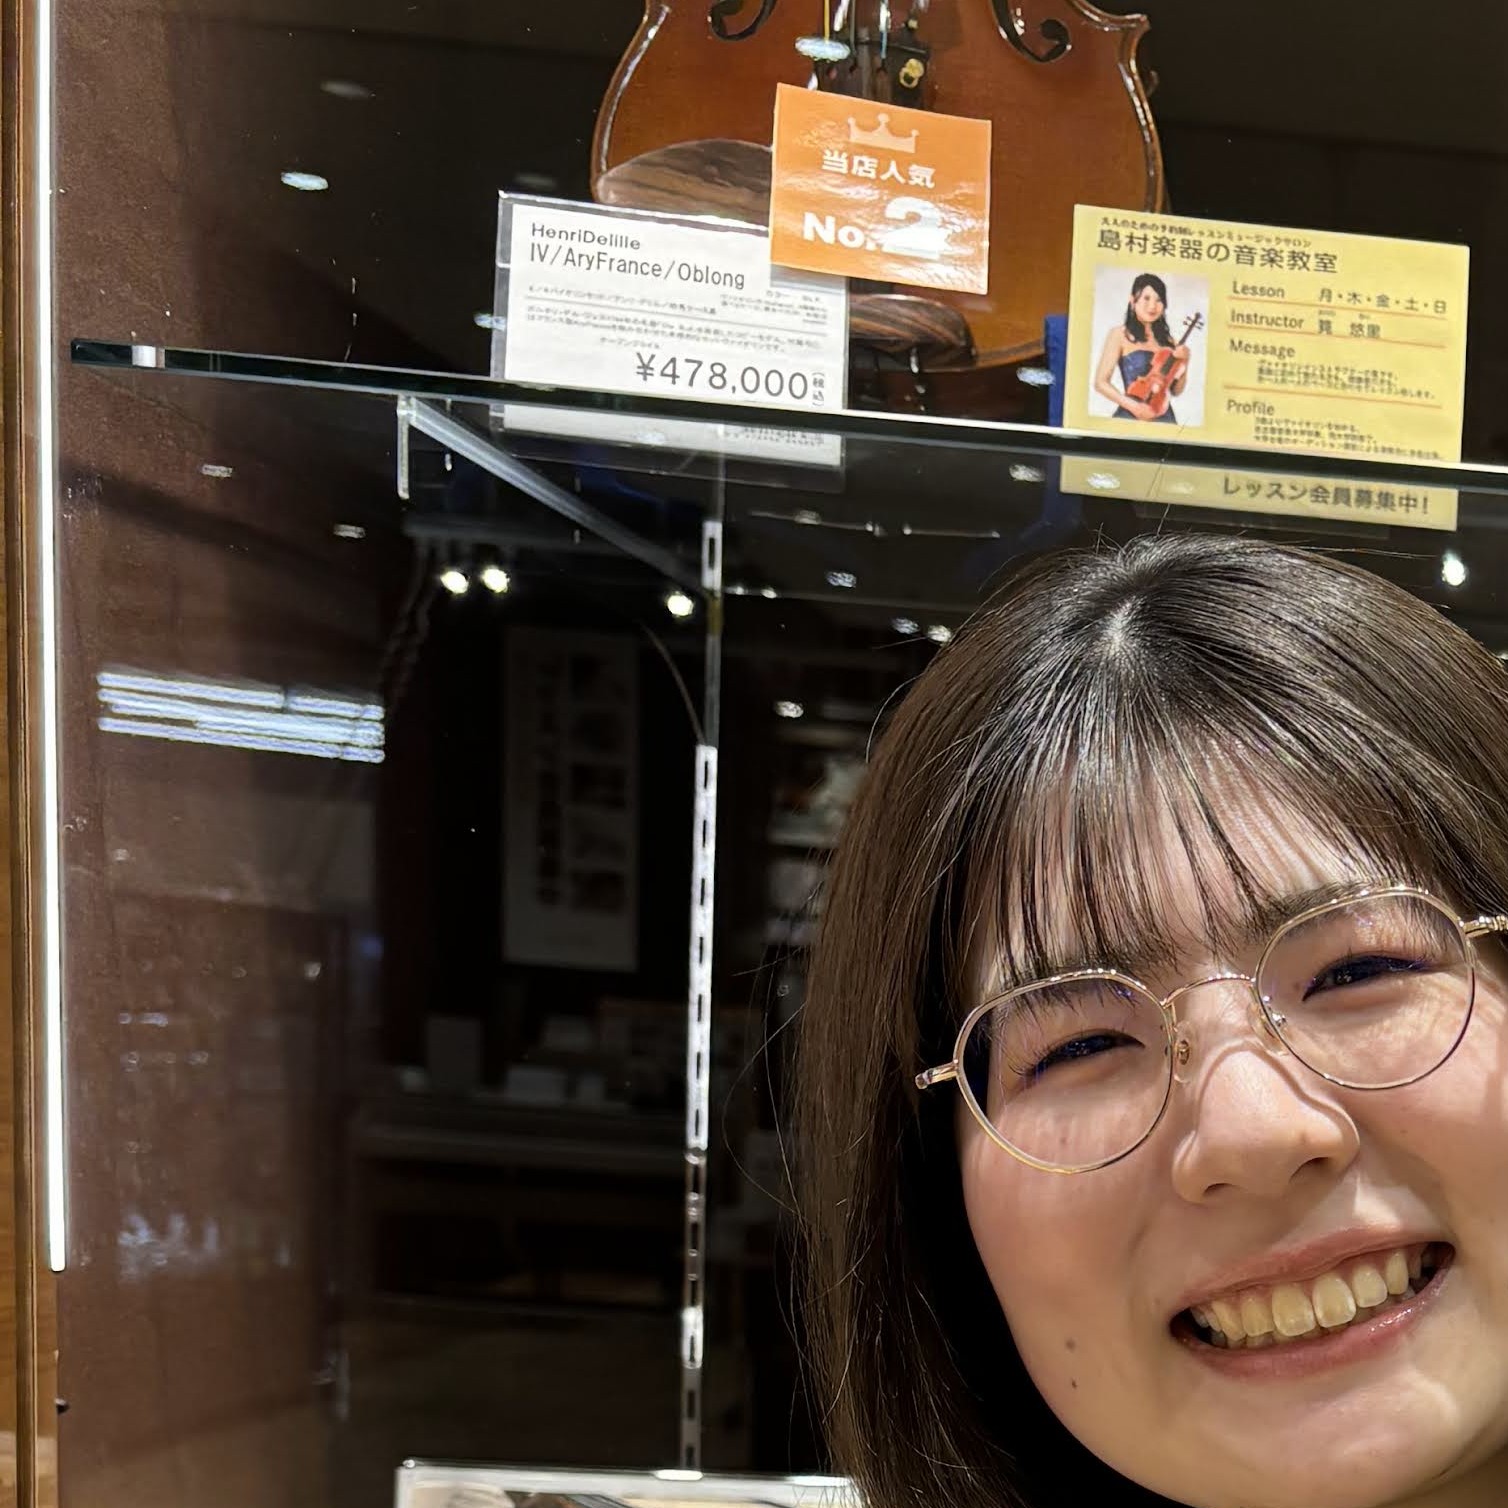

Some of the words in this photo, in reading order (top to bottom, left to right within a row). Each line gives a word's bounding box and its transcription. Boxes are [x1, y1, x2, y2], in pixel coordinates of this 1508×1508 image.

[822, 149, 936, 189] 当店人気
[531, 222, 642, 251] HenriDelille
[803, 196, 952, 260] No.2
[529, 243, 746, 290] IV/AryFrance/Oblong
[1097, 228, 1339, 274] 島村楽器の音楽教室
[1232, 281, 1286, 299] Lesson
[1231, 309, 1305, 329] Instructor
[1229, 339, 1296, 360] Message
[636, 351, 809, 401] ¥478,000
[1227, 398, 1276, 416] Profile
[1223, 476, 1430, 515] レッスン会員募集中!
